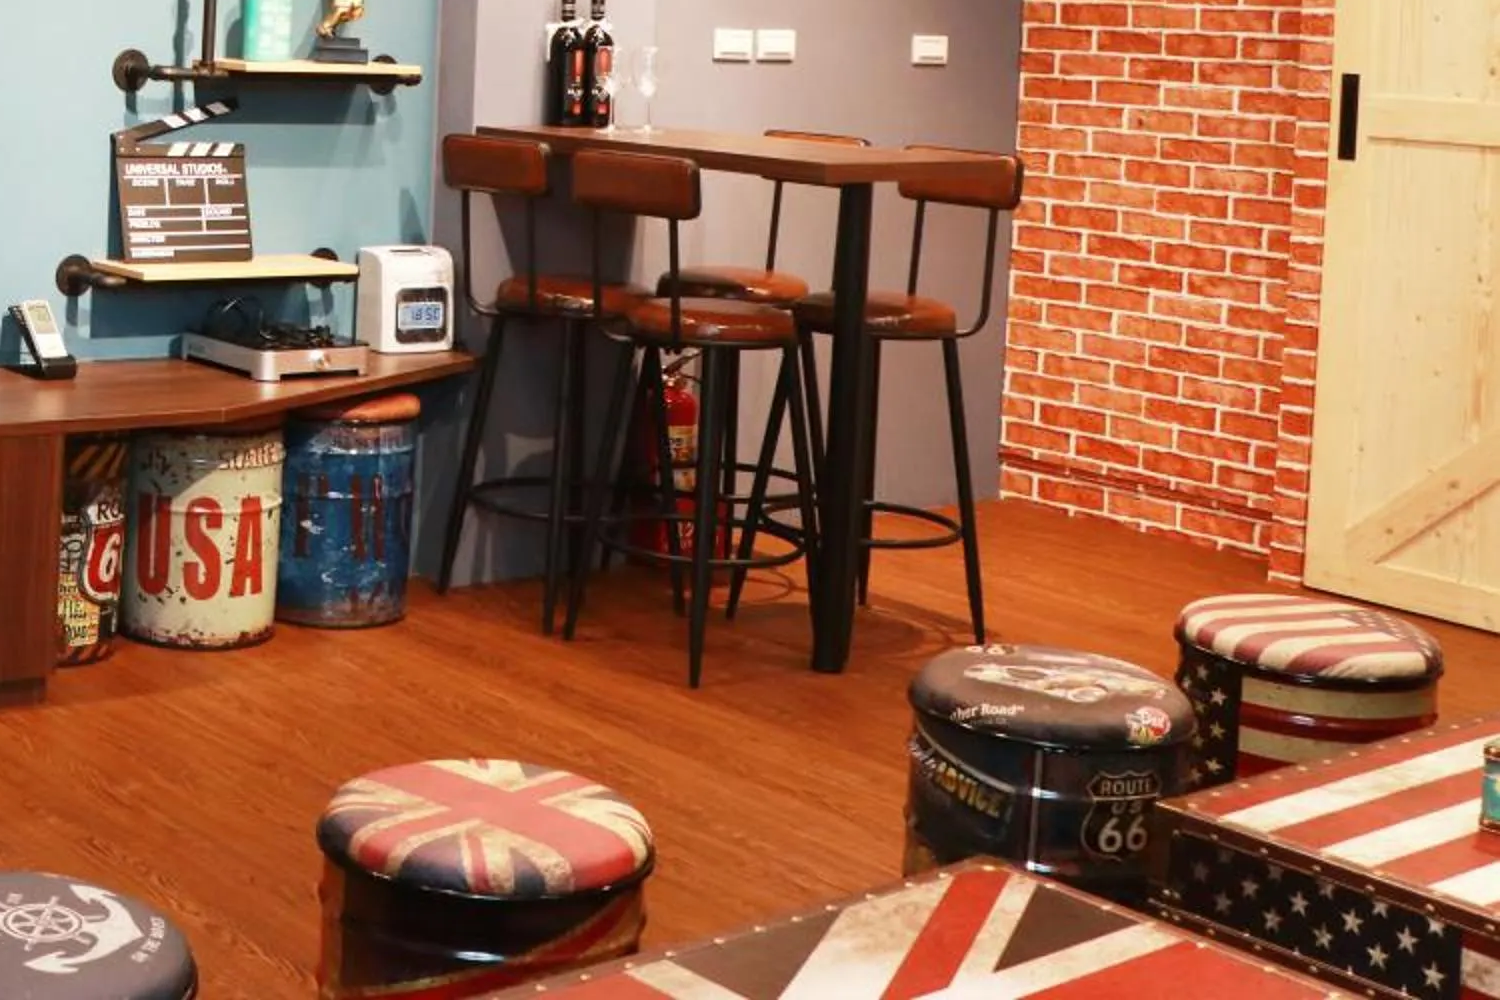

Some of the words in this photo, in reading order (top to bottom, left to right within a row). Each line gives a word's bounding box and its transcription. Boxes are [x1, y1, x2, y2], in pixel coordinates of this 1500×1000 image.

[125, 163, 180, 176] UNIVERSAL
[136, 492, 263, 601] USA
[1101, 778, 1151, 796] ROUTE
[1098, 815, 1148, 853] 66
